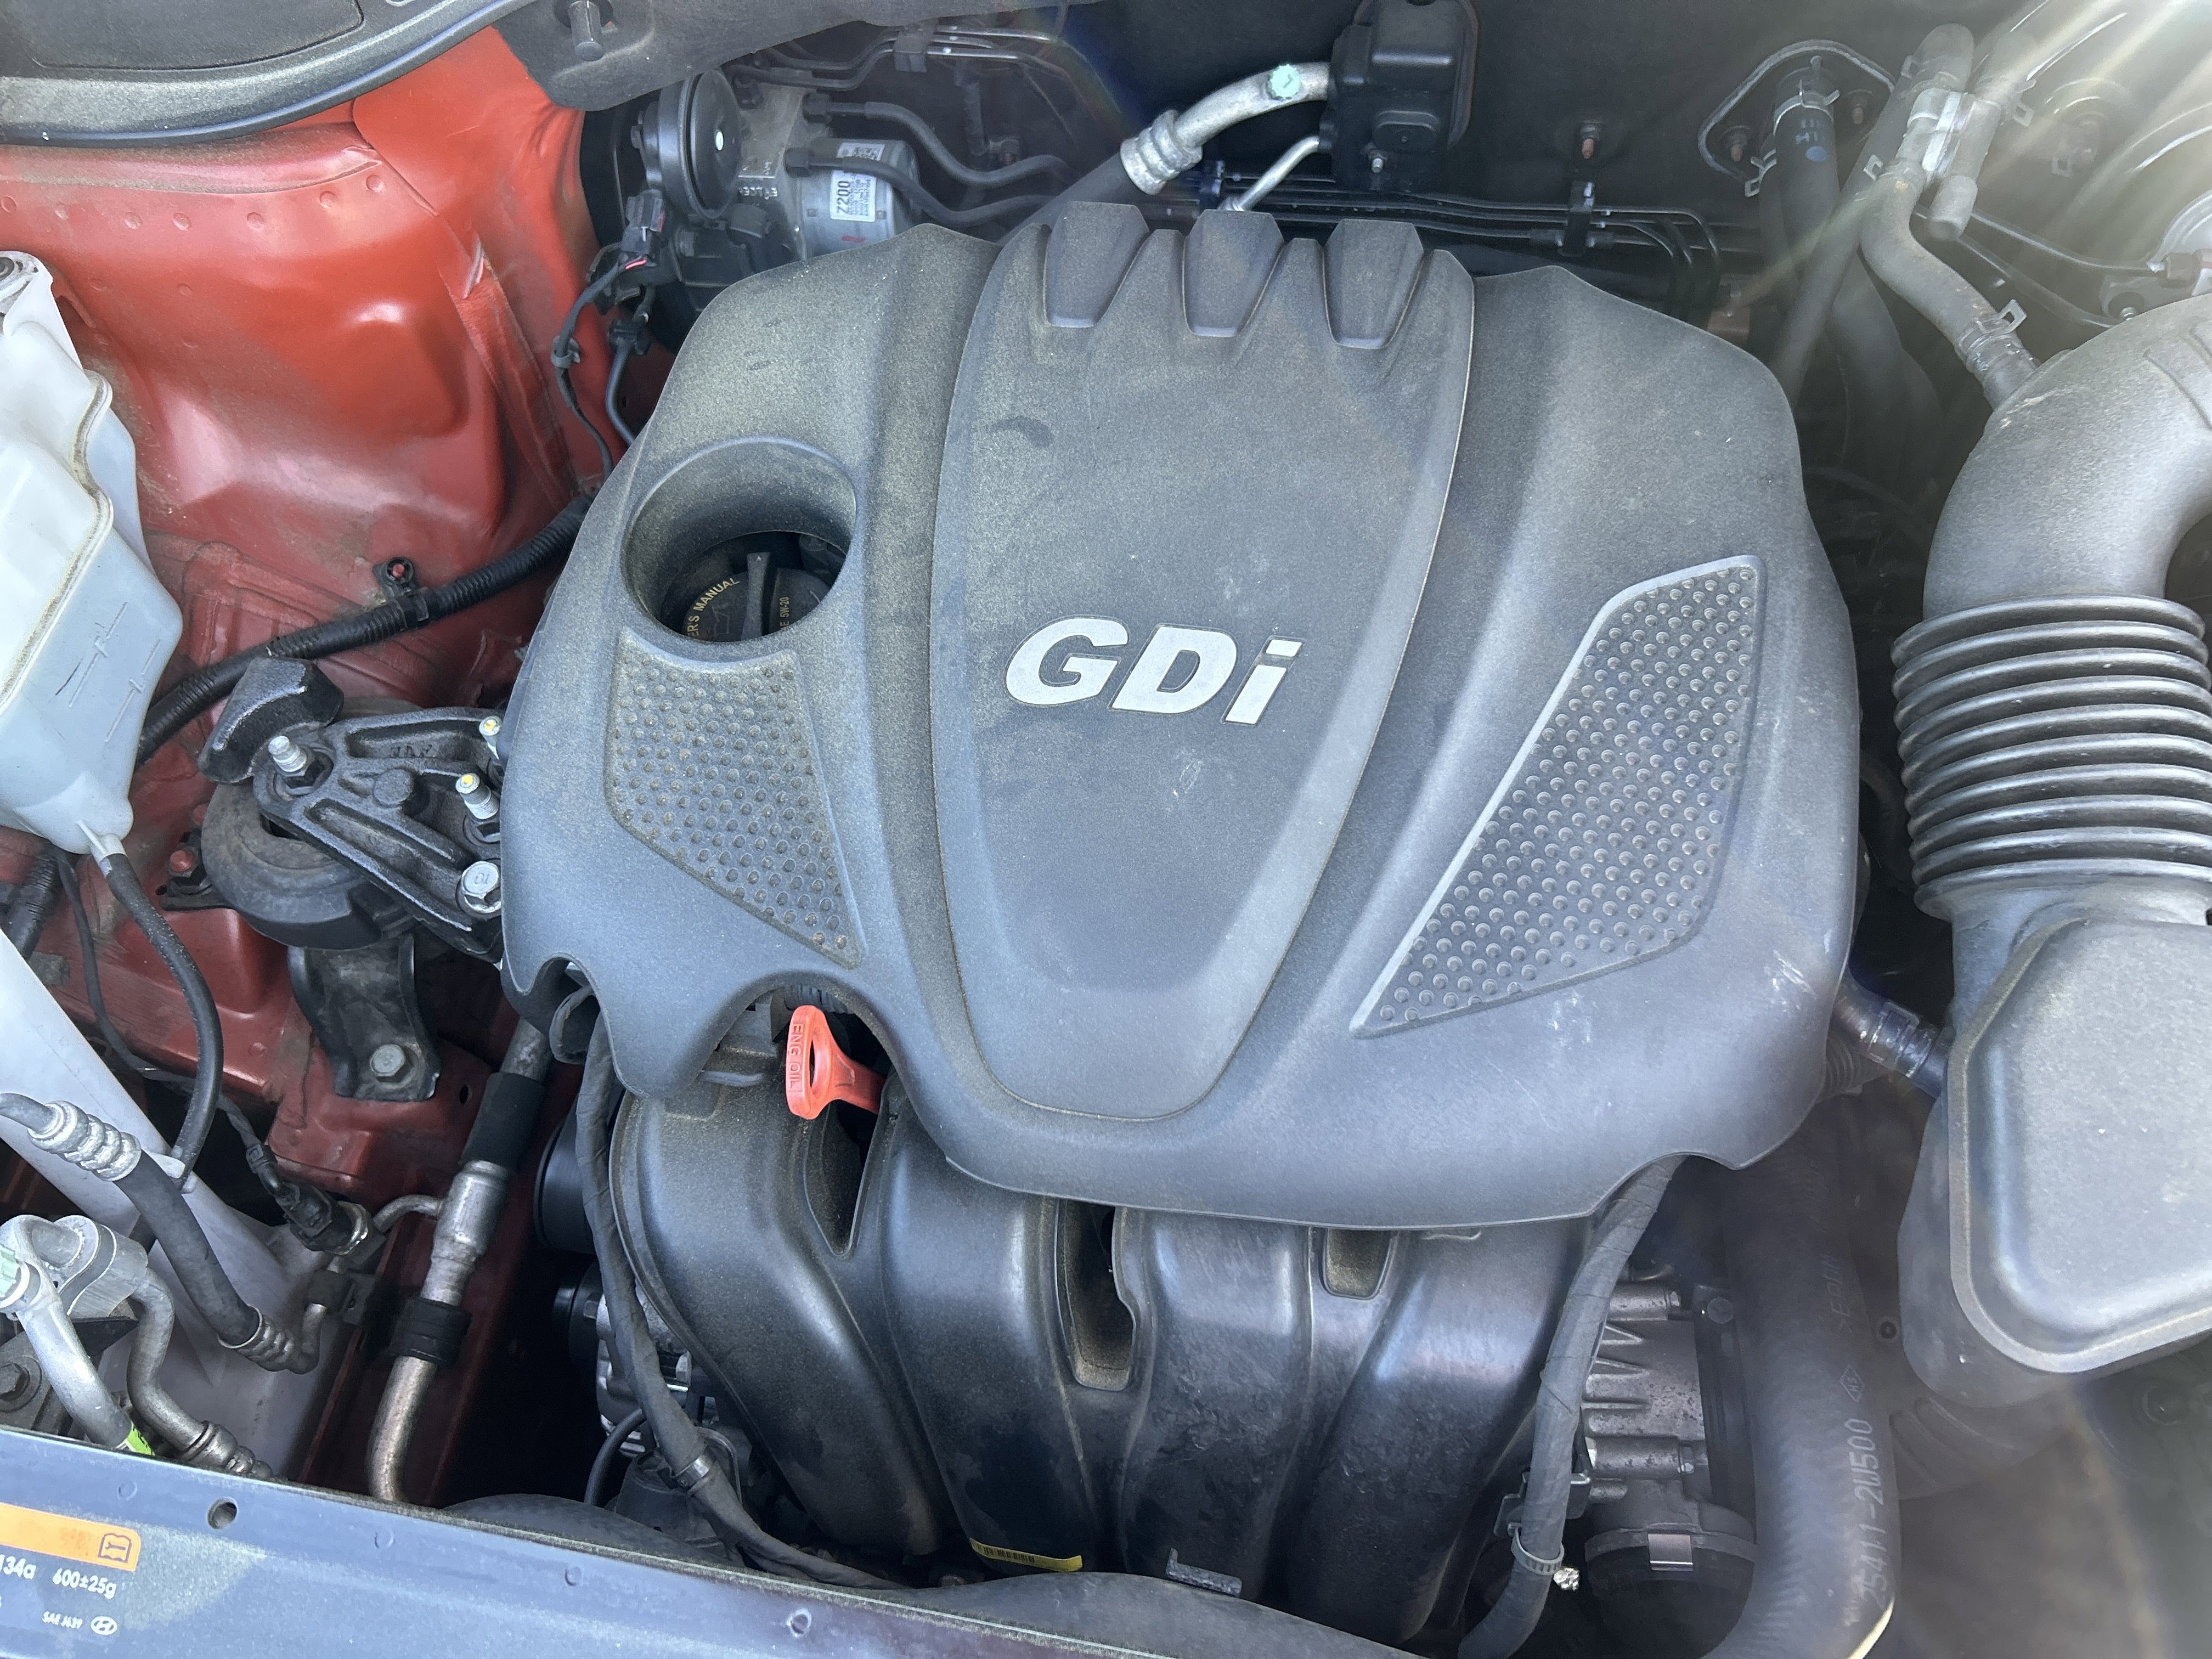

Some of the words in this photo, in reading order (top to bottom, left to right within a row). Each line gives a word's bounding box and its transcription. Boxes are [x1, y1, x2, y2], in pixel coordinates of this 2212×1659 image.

[836, 180, 851, 215] 7200
[693, 578, 741, 611] MANUAL
[780, 596, 789, 618] 5W-20
[1005, 617, 1304, 725] GDi
[789, 1023, 804, 1057] ENG
[788, 1062, 802, 1089] OIL
